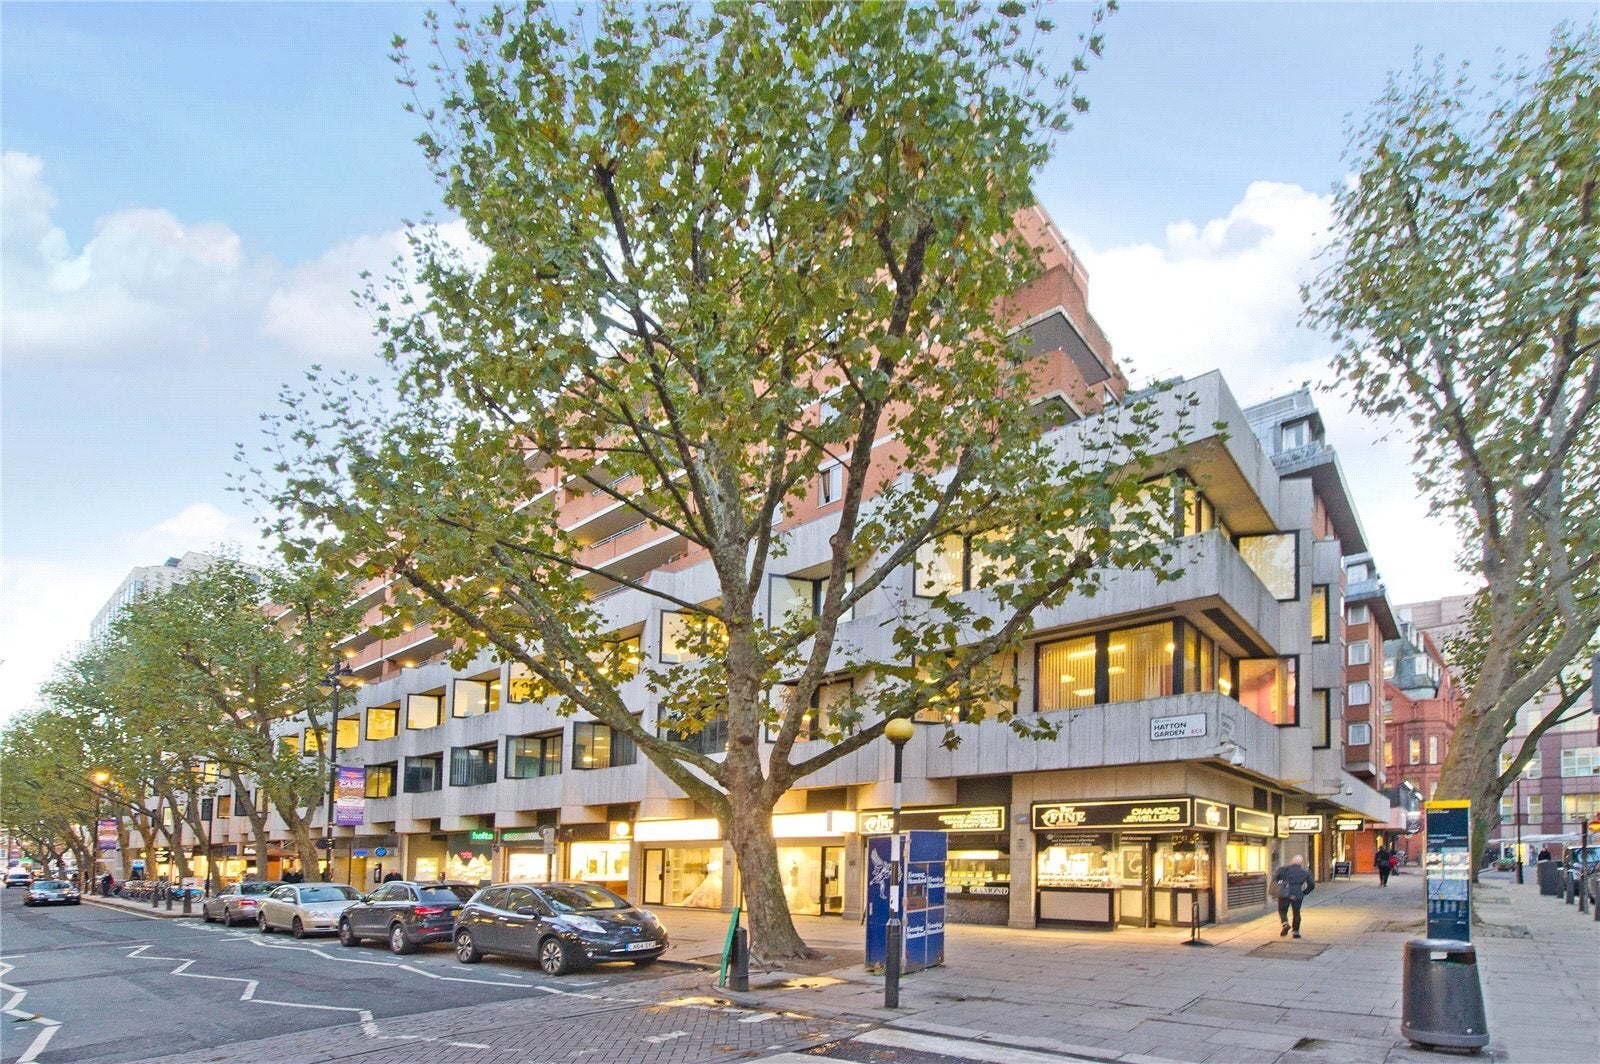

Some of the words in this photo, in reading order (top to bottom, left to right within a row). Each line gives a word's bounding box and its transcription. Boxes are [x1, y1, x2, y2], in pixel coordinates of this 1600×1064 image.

[1153, 721, 1186, 730] HATTON
[1154, 729, 1185, 738] GARDEN
[339, 780, 364, 789] CASH
[1131, 806, 1180, 815] DIAMOND
[1050, 811, 1086, 823] FINE
[1122, 814, 1180, 823] JEWELLERS
[472, 832, 494, 840] holts
[907, 925, 924, 933] Evening
